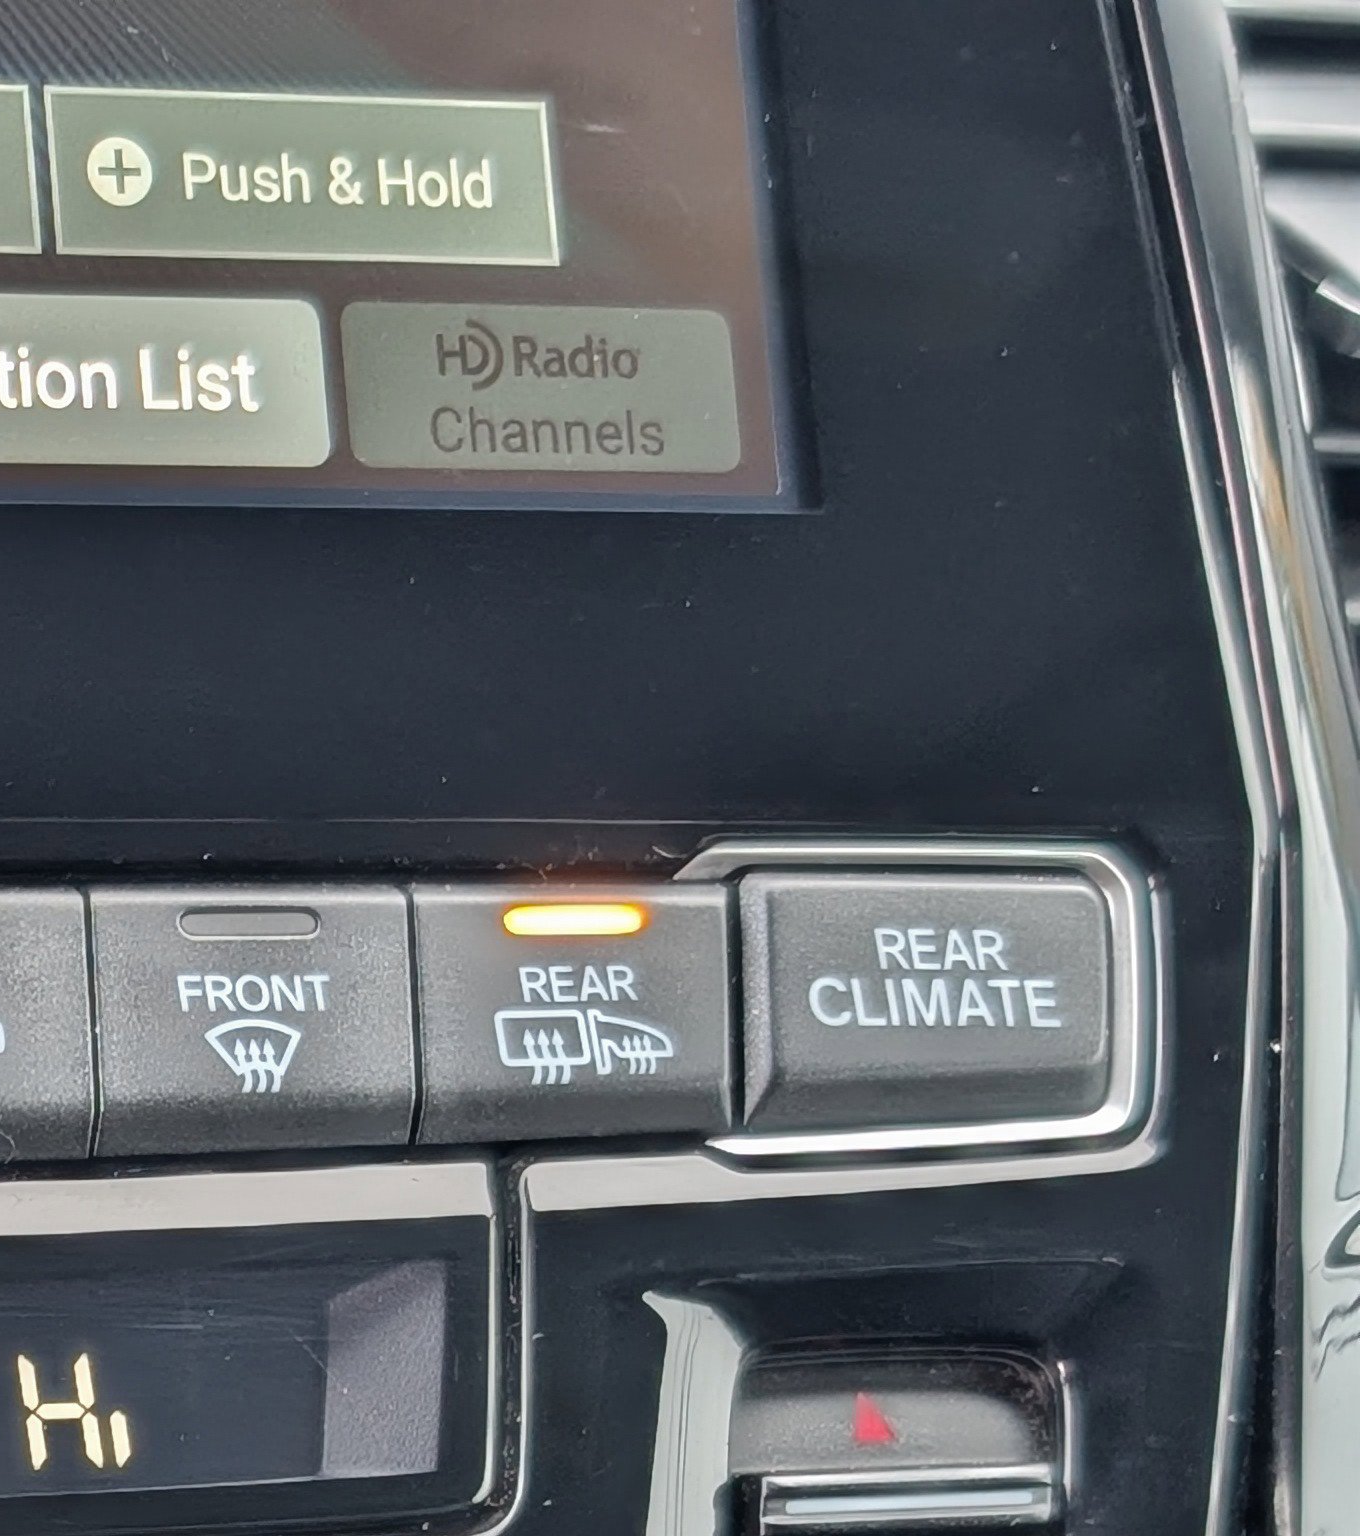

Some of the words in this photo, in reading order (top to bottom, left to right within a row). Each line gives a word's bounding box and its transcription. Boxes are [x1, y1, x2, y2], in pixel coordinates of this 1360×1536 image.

[183, 155, 312, 205] Push
[328, 160, 365, 206] &
[378, 157, 493, 211] Hold
[511, 335, 639, 381] Radio
[141, 352, 261, 416] List
[430, 408, 666, 458] Channels
[874, 927, 1007, 971] REAR
[178, 972, 330, 1012] FRONT
[519, 965, 635, 1003] REAR
[808, 978, 1062, 1030] CLIMATE
